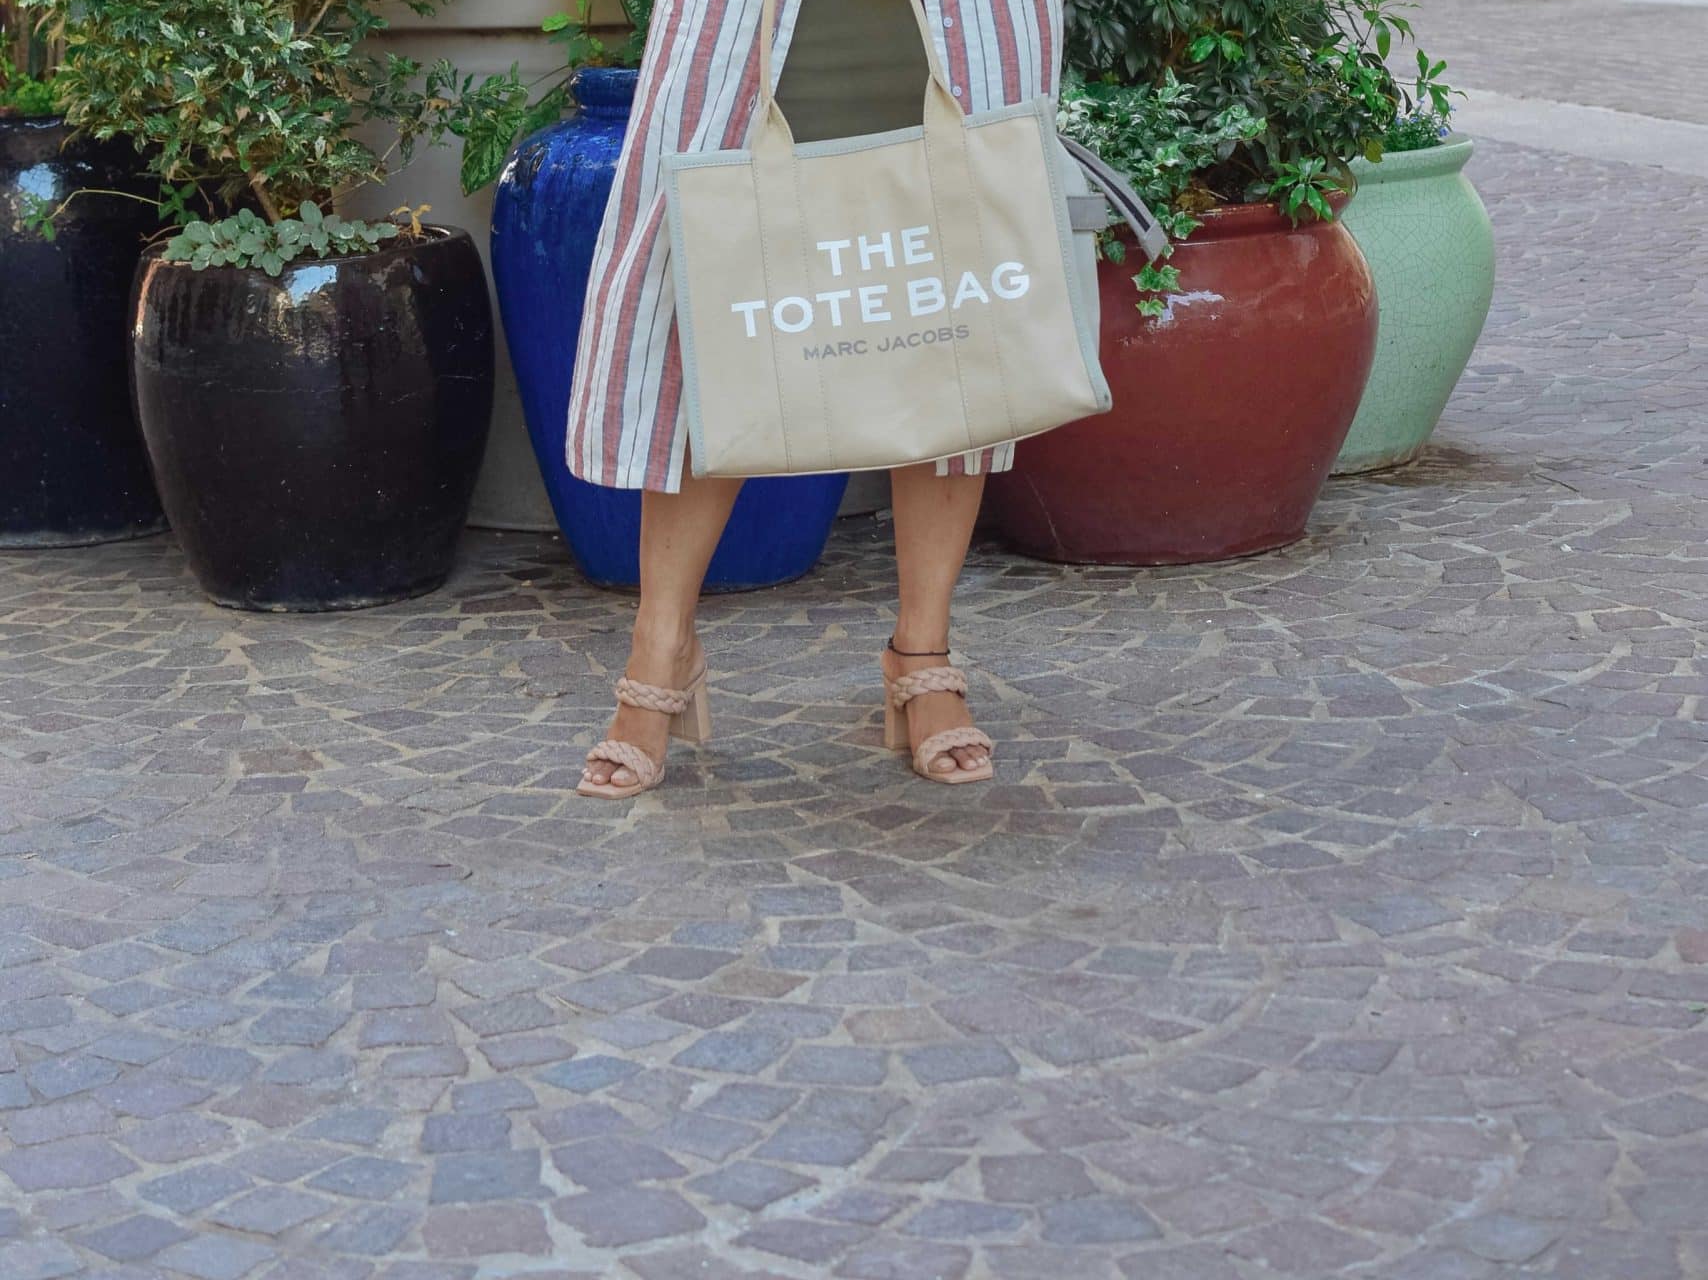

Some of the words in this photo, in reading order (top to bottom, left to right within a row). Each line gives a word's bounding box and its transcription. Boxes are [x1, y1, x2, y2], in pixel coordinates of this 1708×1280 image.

[816, 225, 935, 276] THE
[731, 284, 892, 337] TOTE
[907, 261, 1030, 317] BAG
[803, 340, 868, 361] MARC
[877, 325, 970, 353] JACOBS
